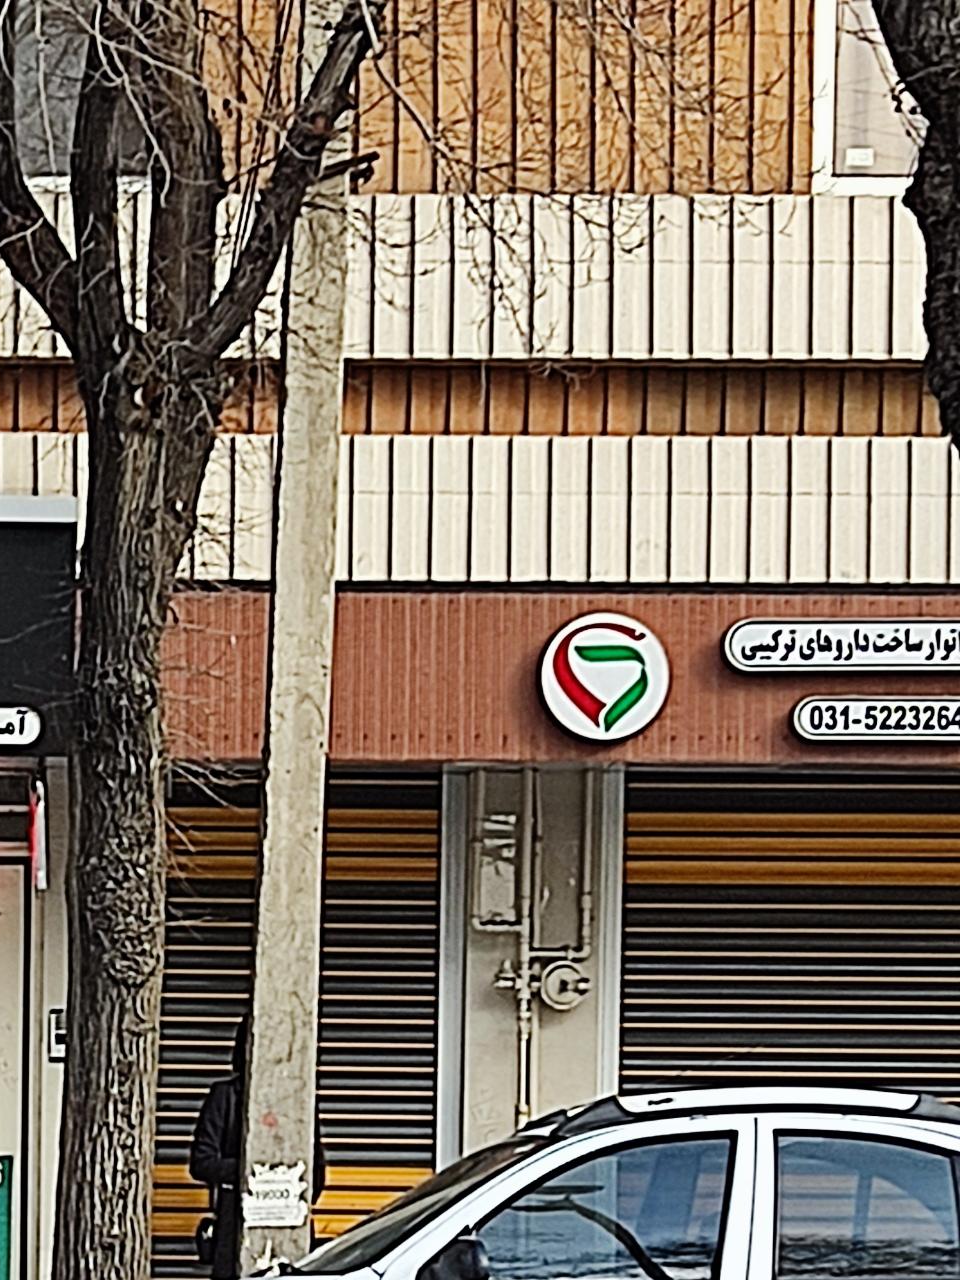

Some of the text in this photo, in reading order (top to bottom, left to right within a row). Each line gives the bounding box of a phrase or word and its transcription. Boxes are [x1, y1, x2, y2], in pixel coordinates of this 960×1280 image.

[741, 629, 797, 661] ترکیبی
[799, 628, 870, 661] داروهای
[872, 627, 924, 653] ساخت
